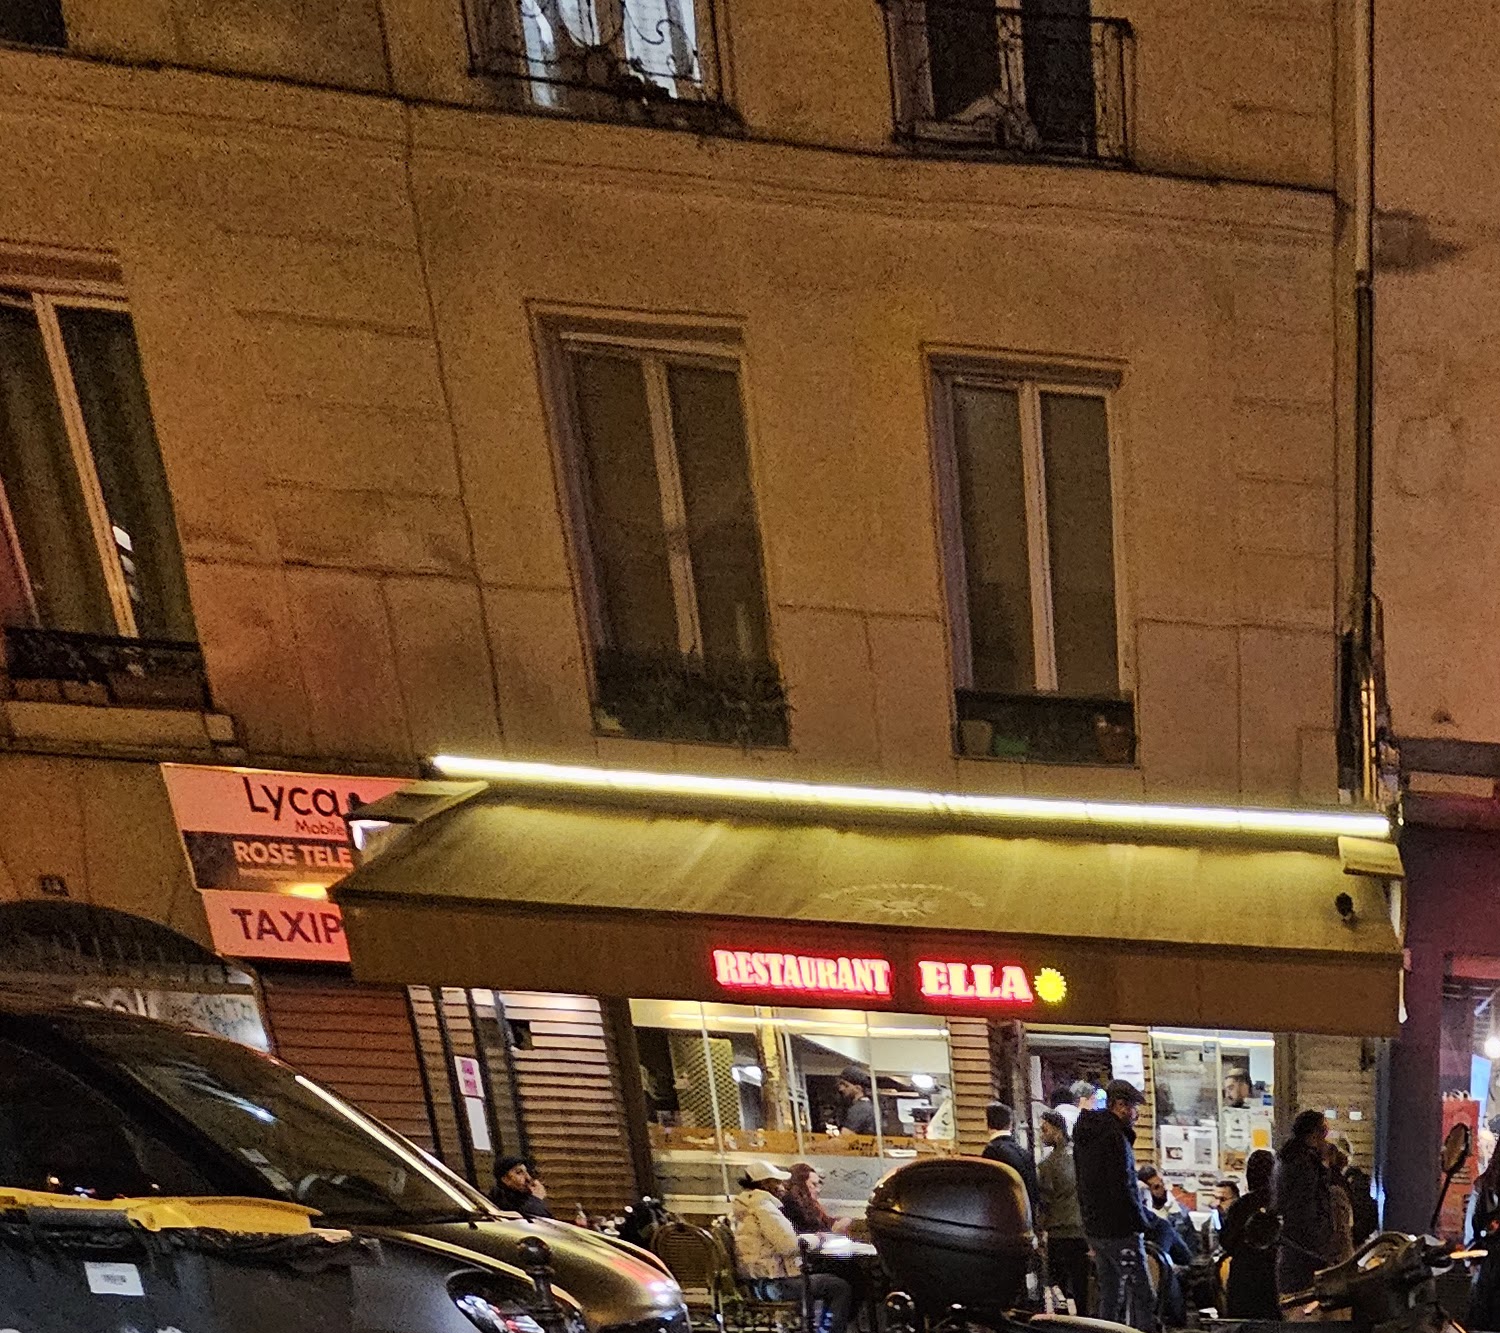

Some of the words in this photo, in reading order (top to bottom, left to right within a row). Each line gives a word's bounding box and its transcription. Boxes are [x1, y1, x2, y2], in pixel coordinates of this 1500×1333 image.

[242, 776, 345, 821] Lyca
[295, 819, 346, 838] Mobile
[232, 840, 297, 865] ROSE
[299, 845, 353, 869] TELE
[712, 949, 891, 995] RESTAURANT
[918, 960, 1033, 1003] ELLA
